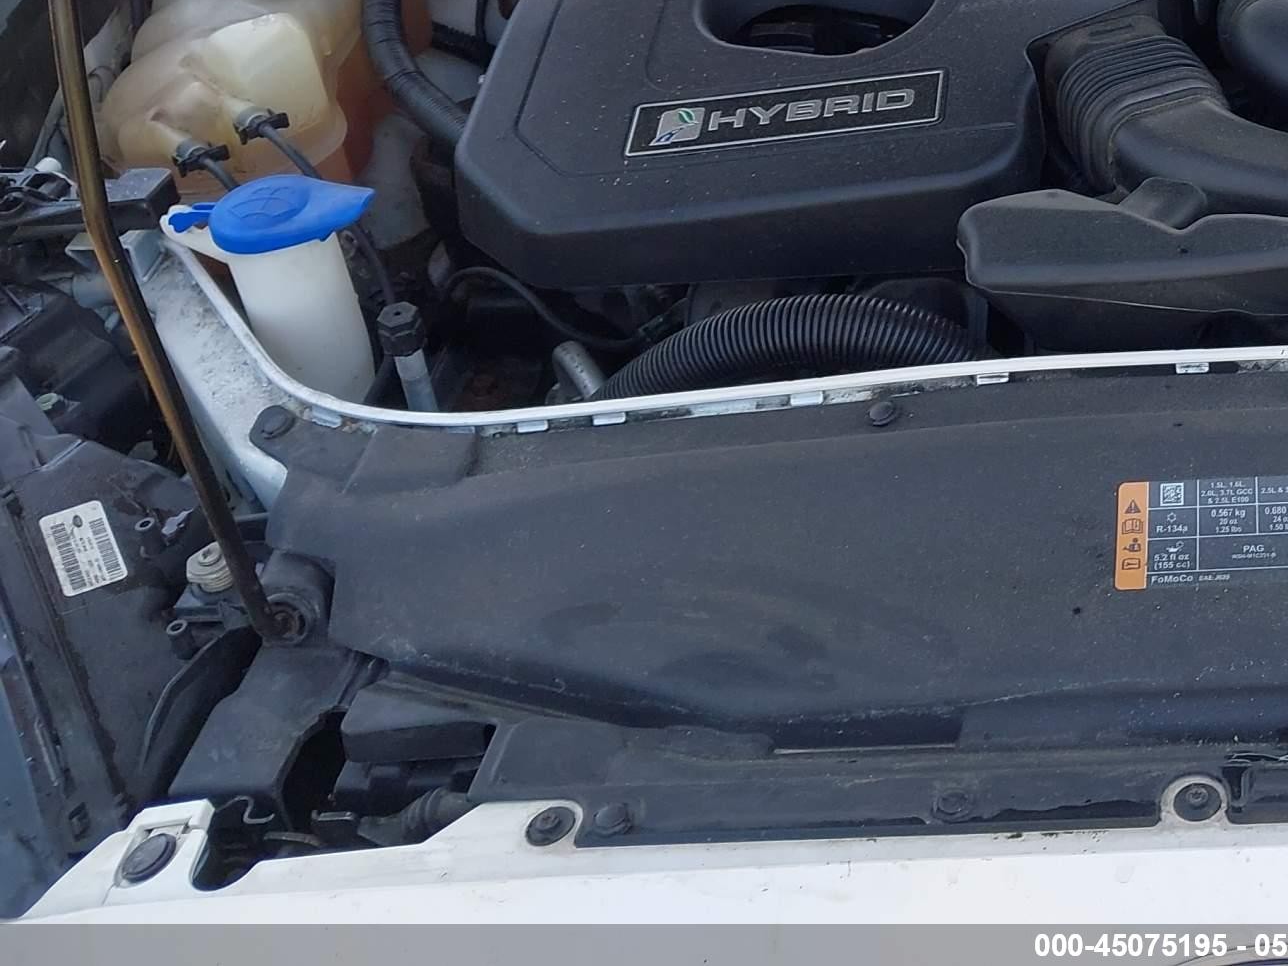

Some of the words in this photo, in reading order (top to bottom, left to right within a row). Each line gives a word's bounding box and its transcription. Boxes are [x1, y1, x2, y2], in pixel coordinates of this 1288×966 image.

[708, 89, 915, 131] HYBRID
[1235, 508, 1245, 517] kg
[1151, 575, 1193, 583] FoMoCo
